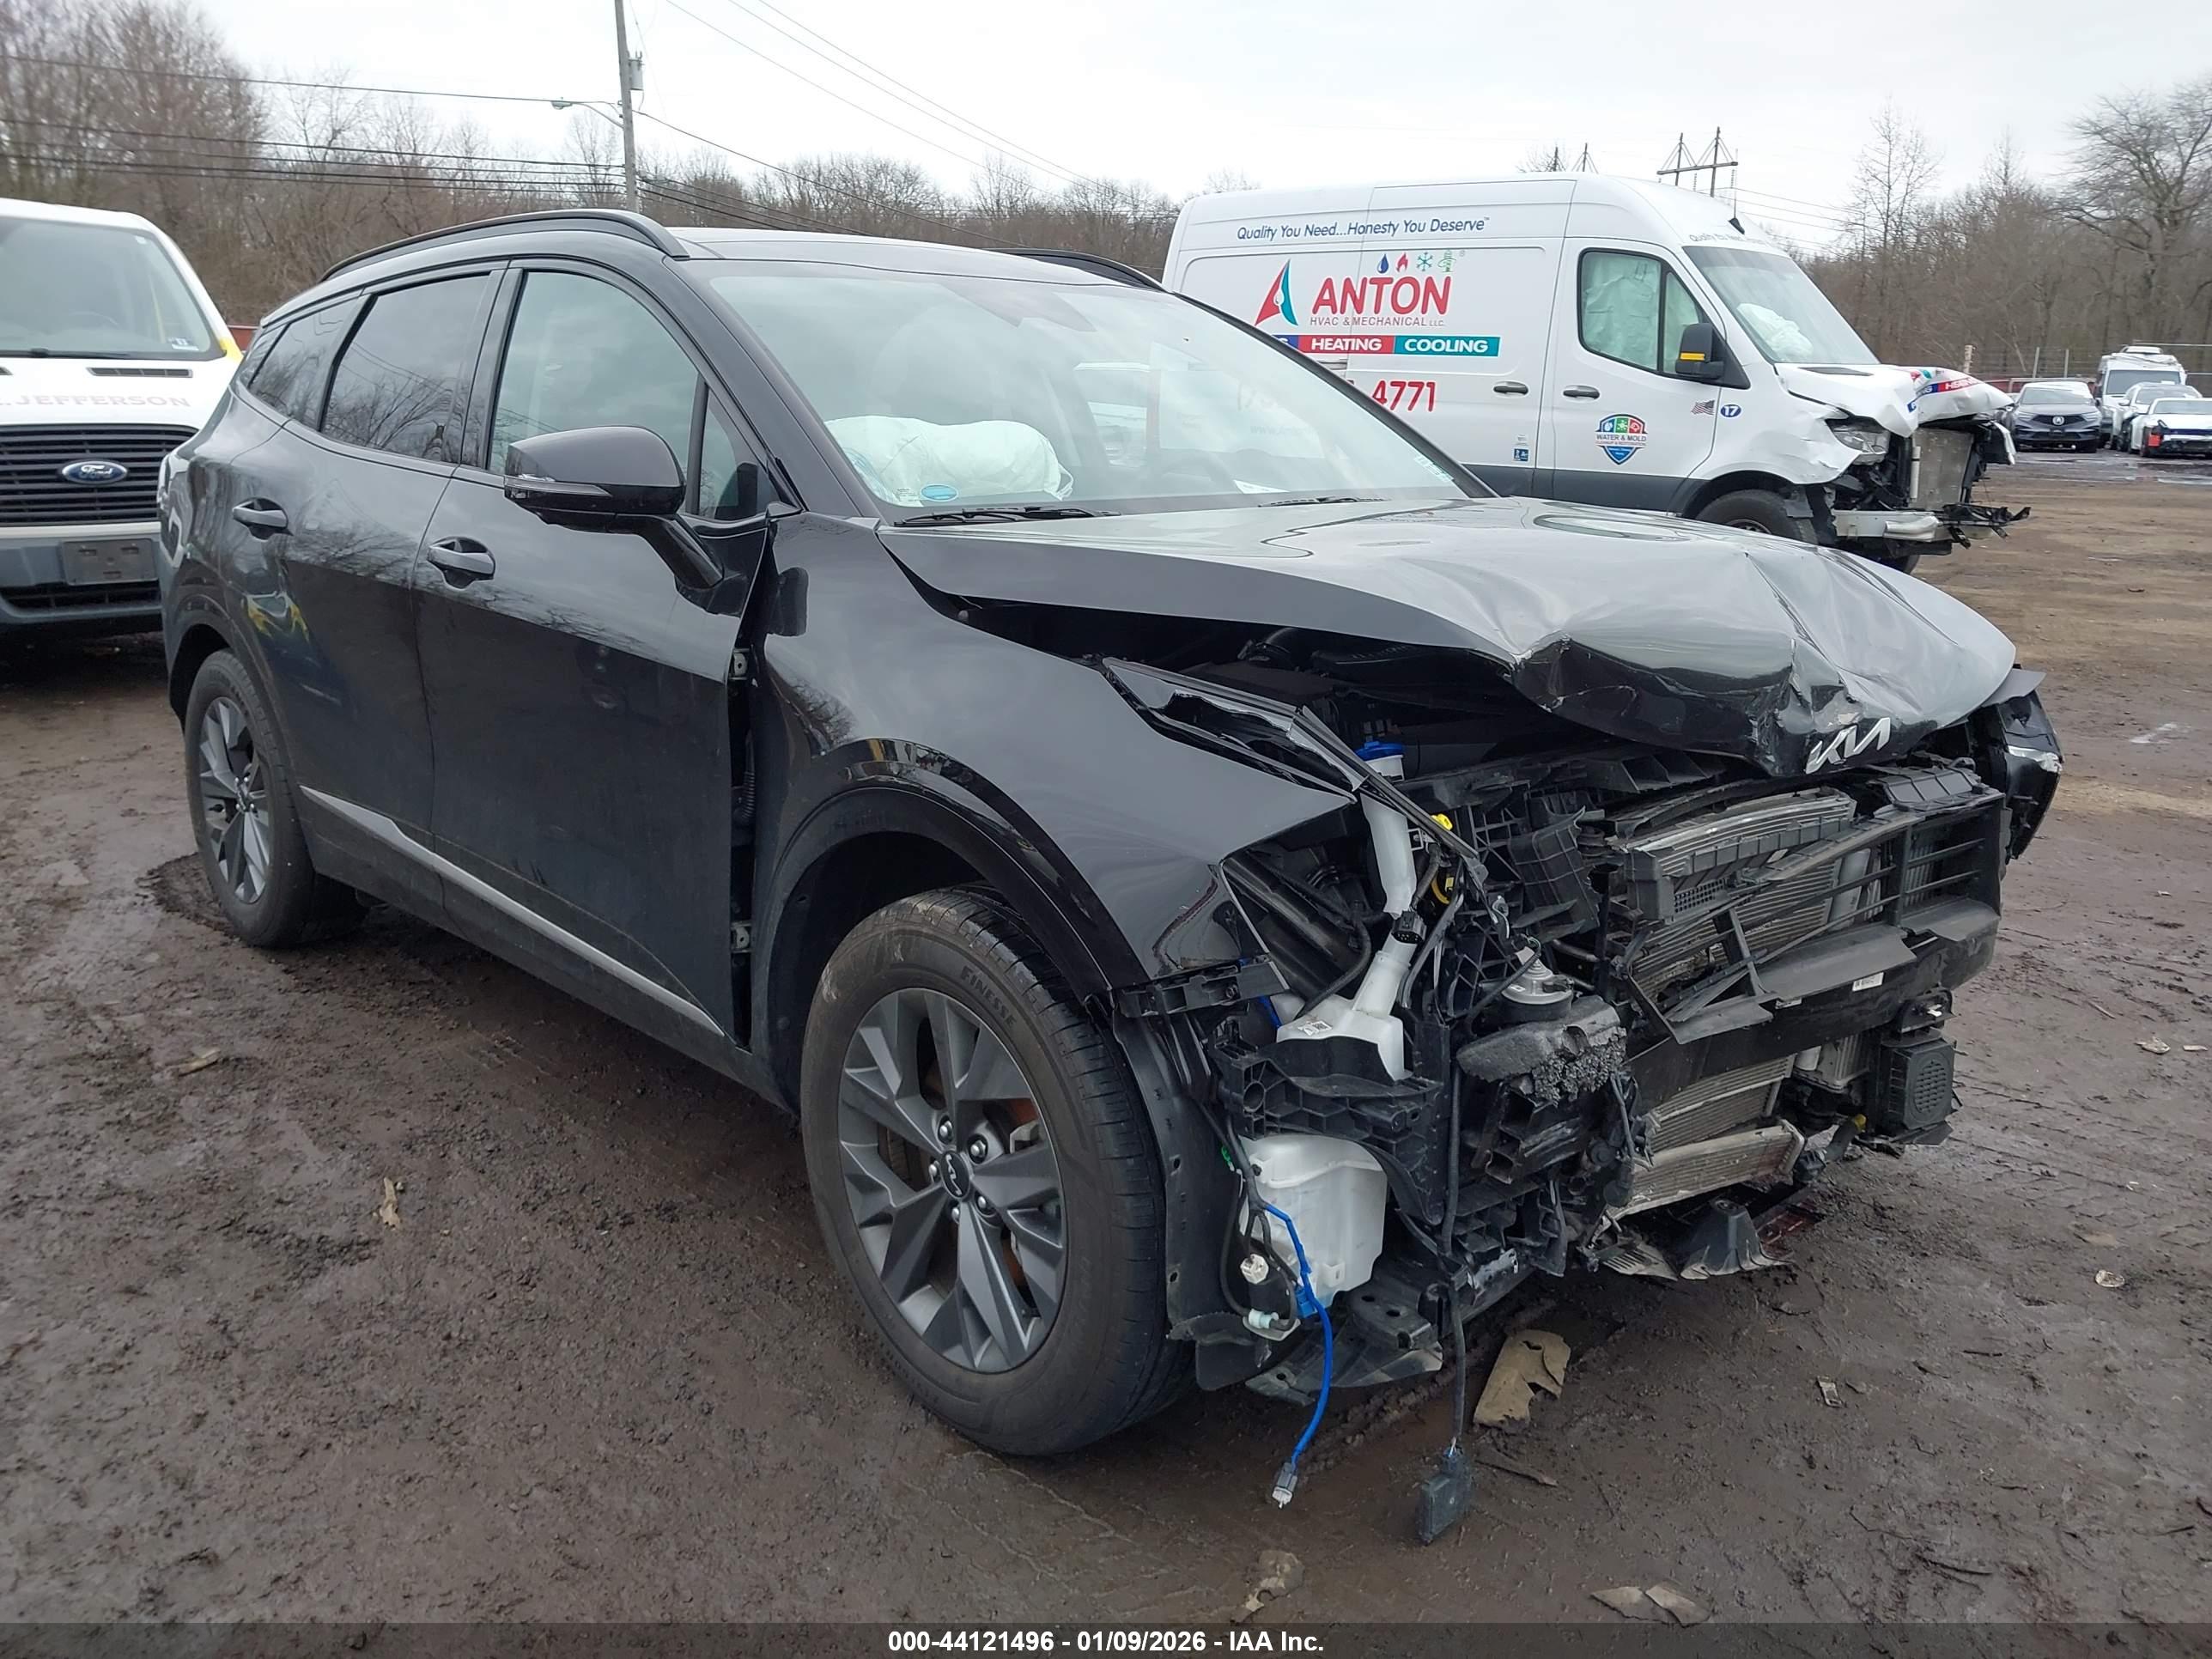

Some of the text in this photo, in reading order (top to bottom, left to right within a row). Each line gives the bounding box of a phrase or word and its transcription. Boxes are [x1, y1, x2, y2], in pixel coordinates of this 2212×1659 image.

[1237, 226, 1278, 241] Quality
[1280, 224, 1301, 238] You
[1403, 219, 1426, 234] You
[1311, 275, 1452, 315] ANTON
[1310, 316, 1339, 326] HVAC
[1310, 337, 1489, 353] HEATING COOLING
[15, 394, 191, 407] JEFFERSON
[1723, 405, 1740, 416] 17
[961, 965, 1017, 1026] FINESSE
